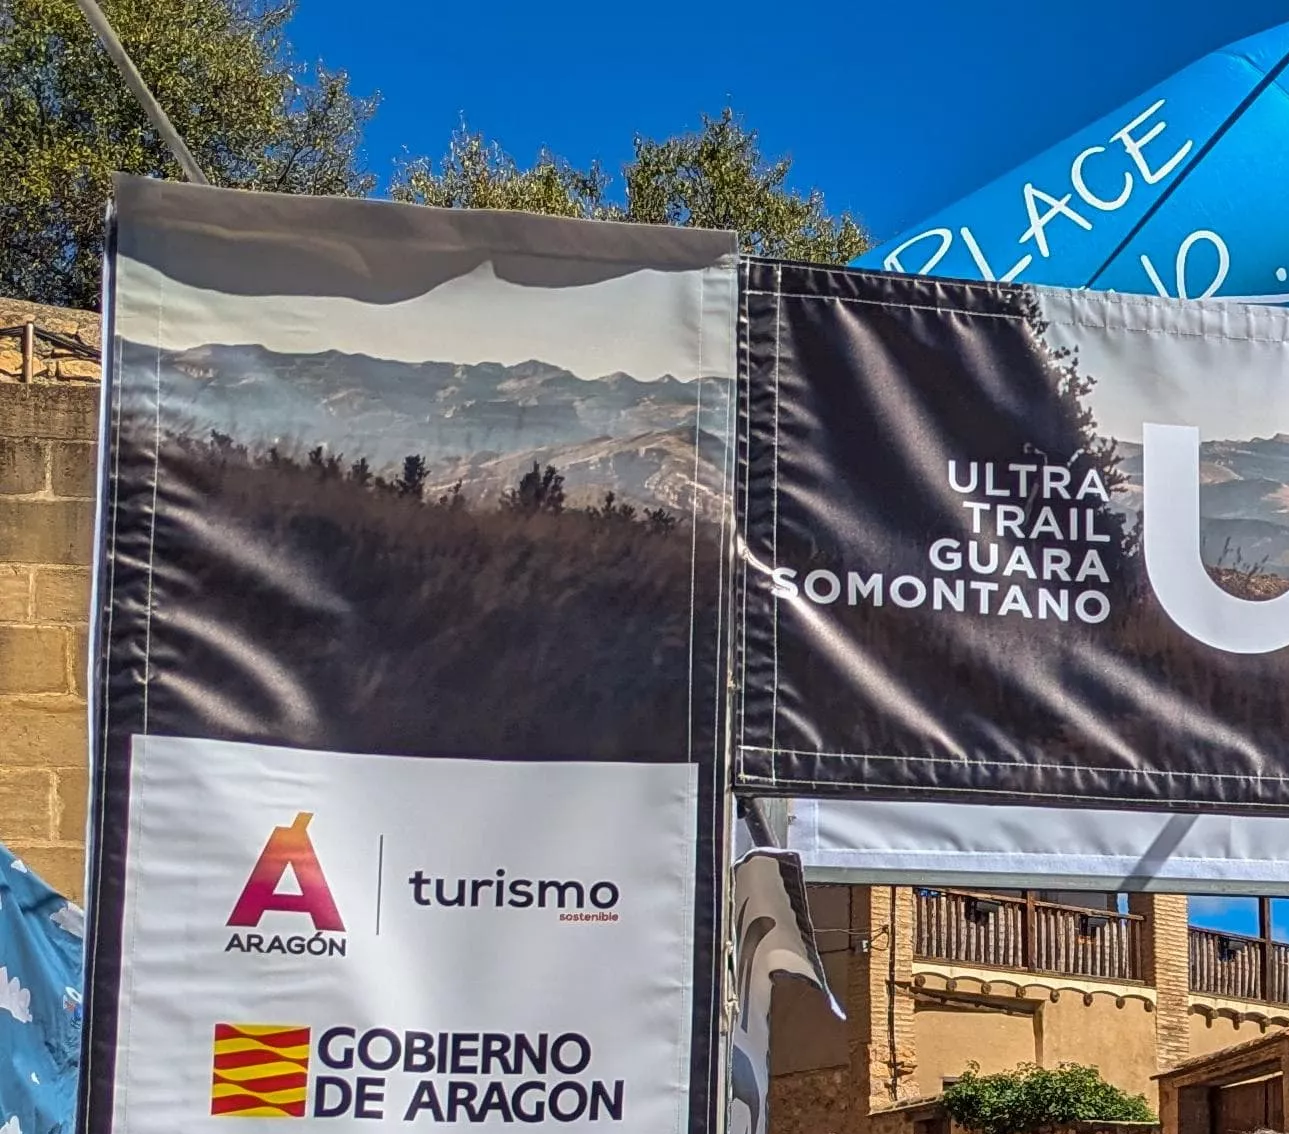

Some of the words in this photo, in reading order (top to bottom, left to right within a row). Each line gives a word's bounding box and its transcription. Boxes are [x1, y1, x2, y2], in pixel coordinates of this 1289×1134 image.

[948, 460, 1110, 502] ULTRA
[962, 501, 1111, 542] TRAIL
[929, 538, 1110, 583] GUARA
[770, 567, 1111, 624] SOMONTANO
[408, 869, 620, 909] turismo
[558, 911, 620, 922] sostenible
[225, 931, 347, 957] ARAGÓN
[317, 1027, 592, 1075] GOBIERNO
[313, 1078, 386, 1119] DE
[404, 1080, 624, 1122] ARAGON
